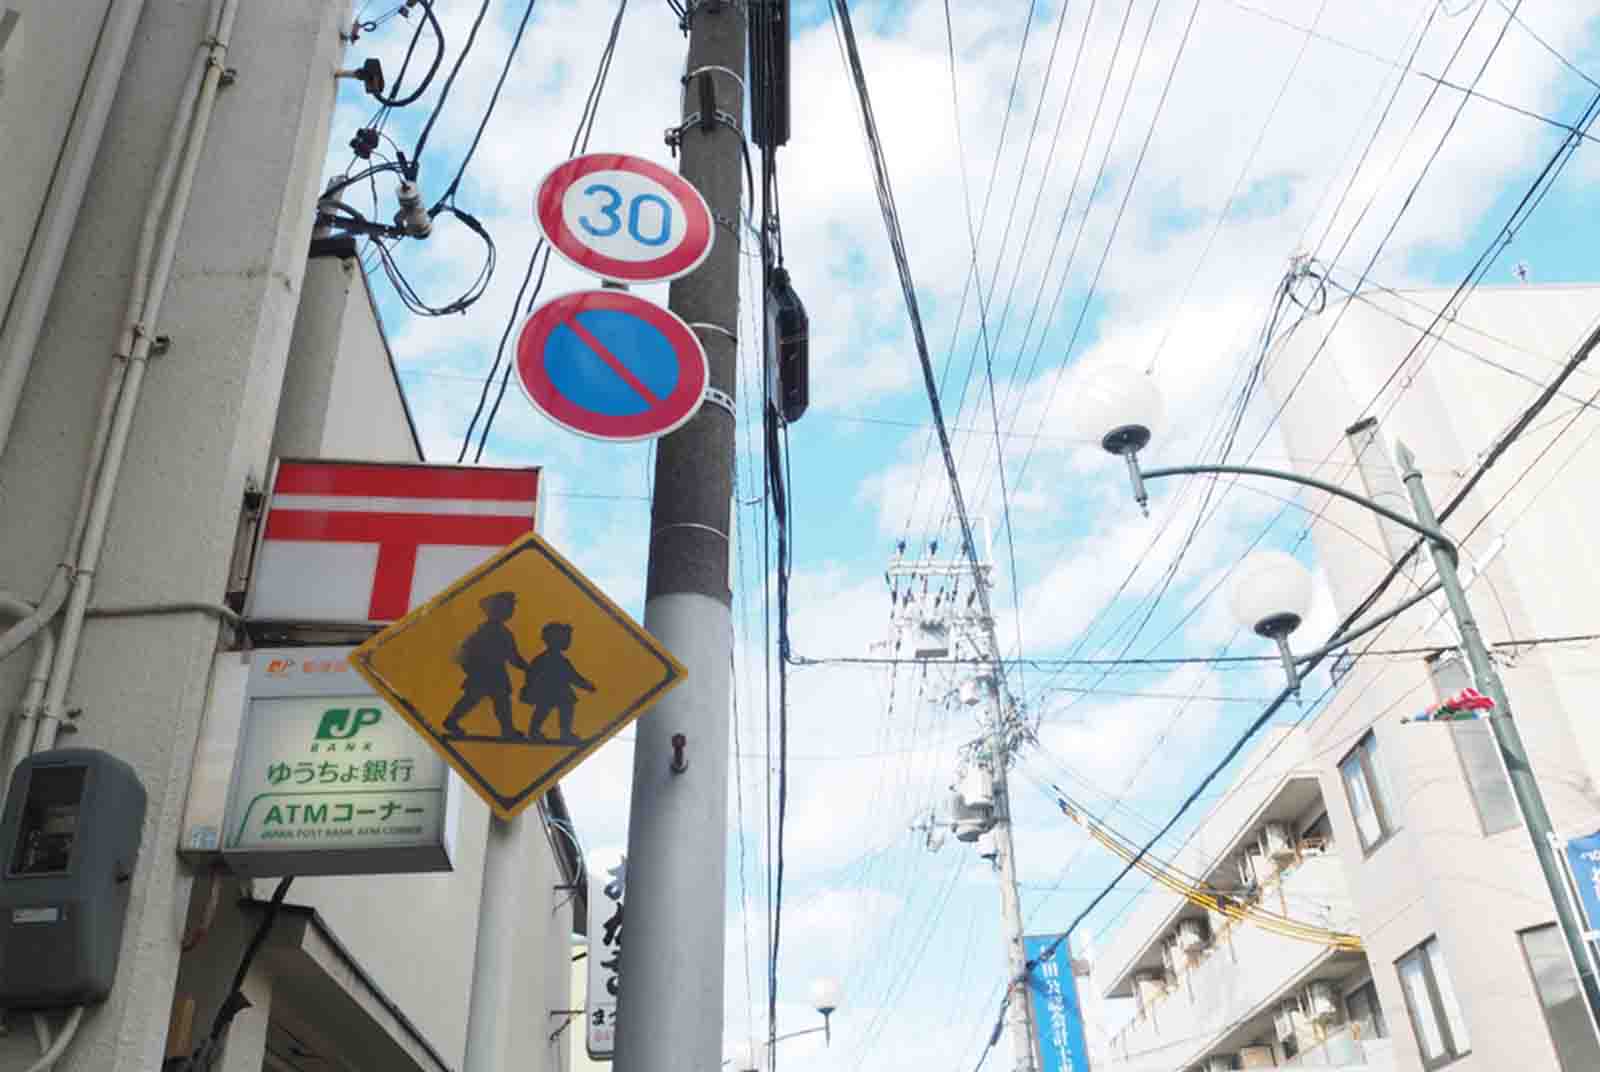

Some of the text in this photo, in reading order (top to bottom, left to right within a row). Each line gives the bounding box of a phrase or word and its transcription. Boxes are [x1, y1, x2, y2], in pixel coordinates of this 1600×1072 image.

[578, 184, 673, 246] 30
[314, 707, 382, 740] JP
[310, 742, 375, 753] BANK
[267, 758, 415, 785] ゆうちょ銀行
